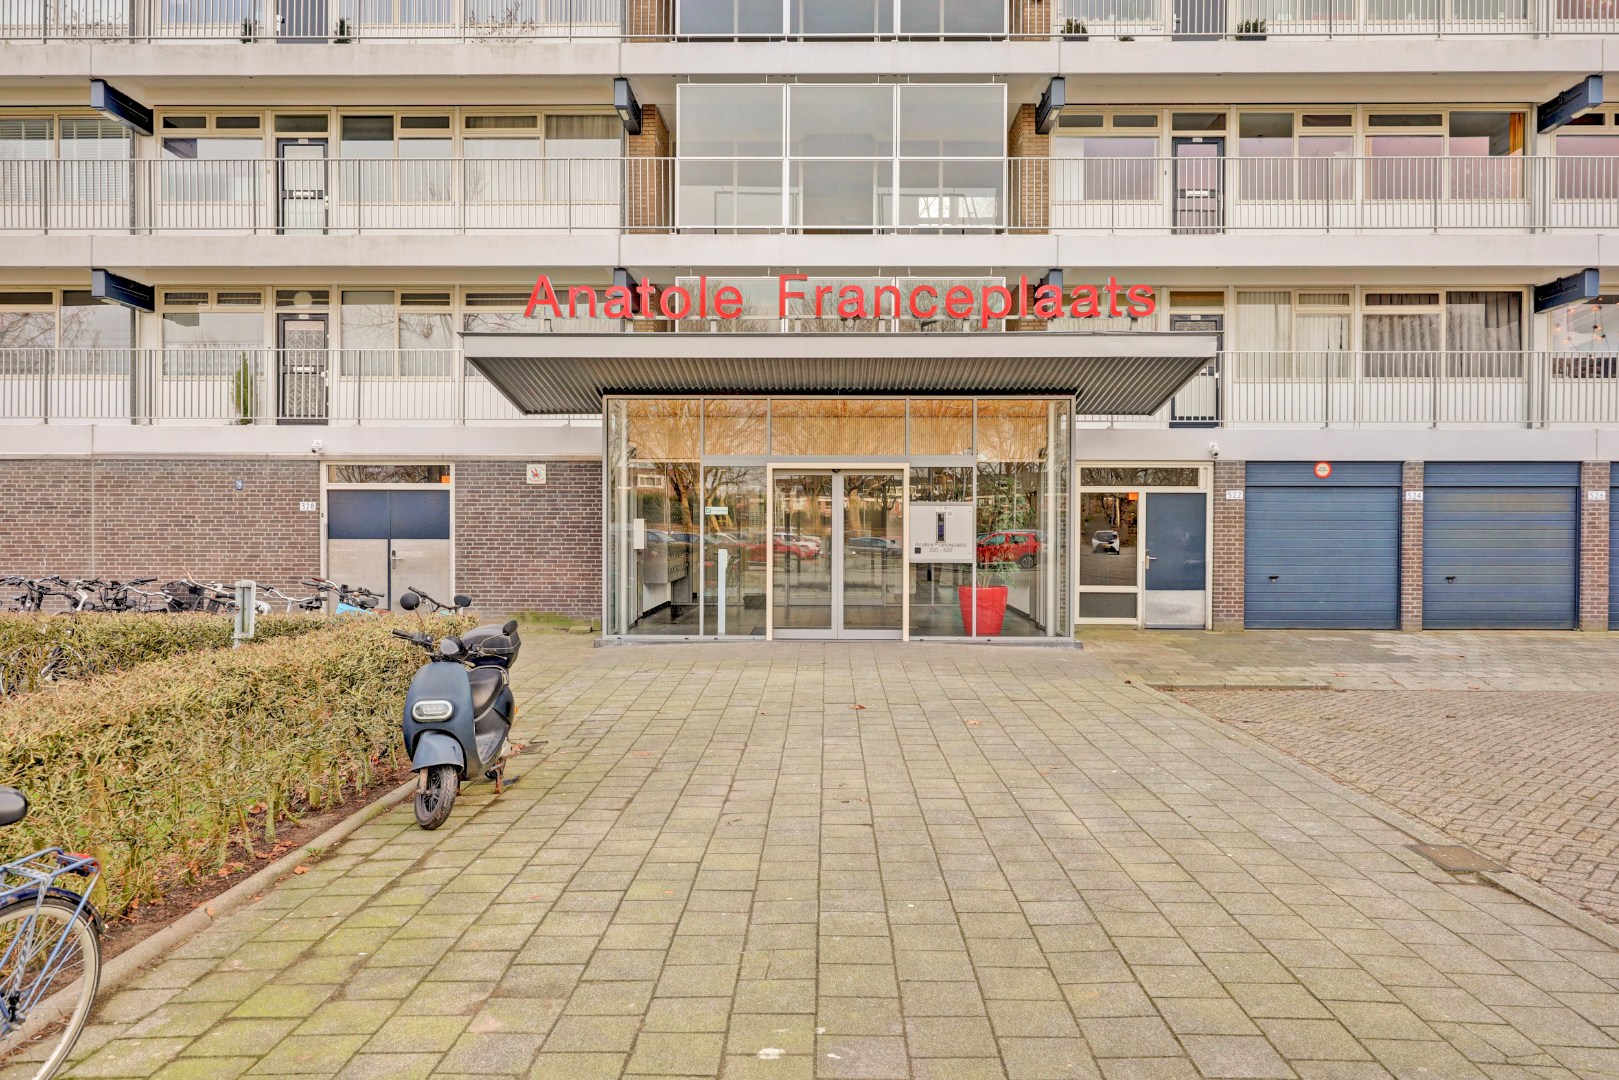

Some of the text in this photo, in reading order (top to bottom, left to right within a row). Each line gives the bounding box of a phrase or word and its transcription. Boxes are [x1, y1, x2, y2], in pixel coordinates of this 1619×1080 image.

[523, 273, 1157, 329] Anatole Franceplaats
[1227, 491, 1242, 499] 522
[1407, 492, 1422, 500] 524
[1589, 491, 1604, 499] 526
[301, 502, 315, 510] 328
